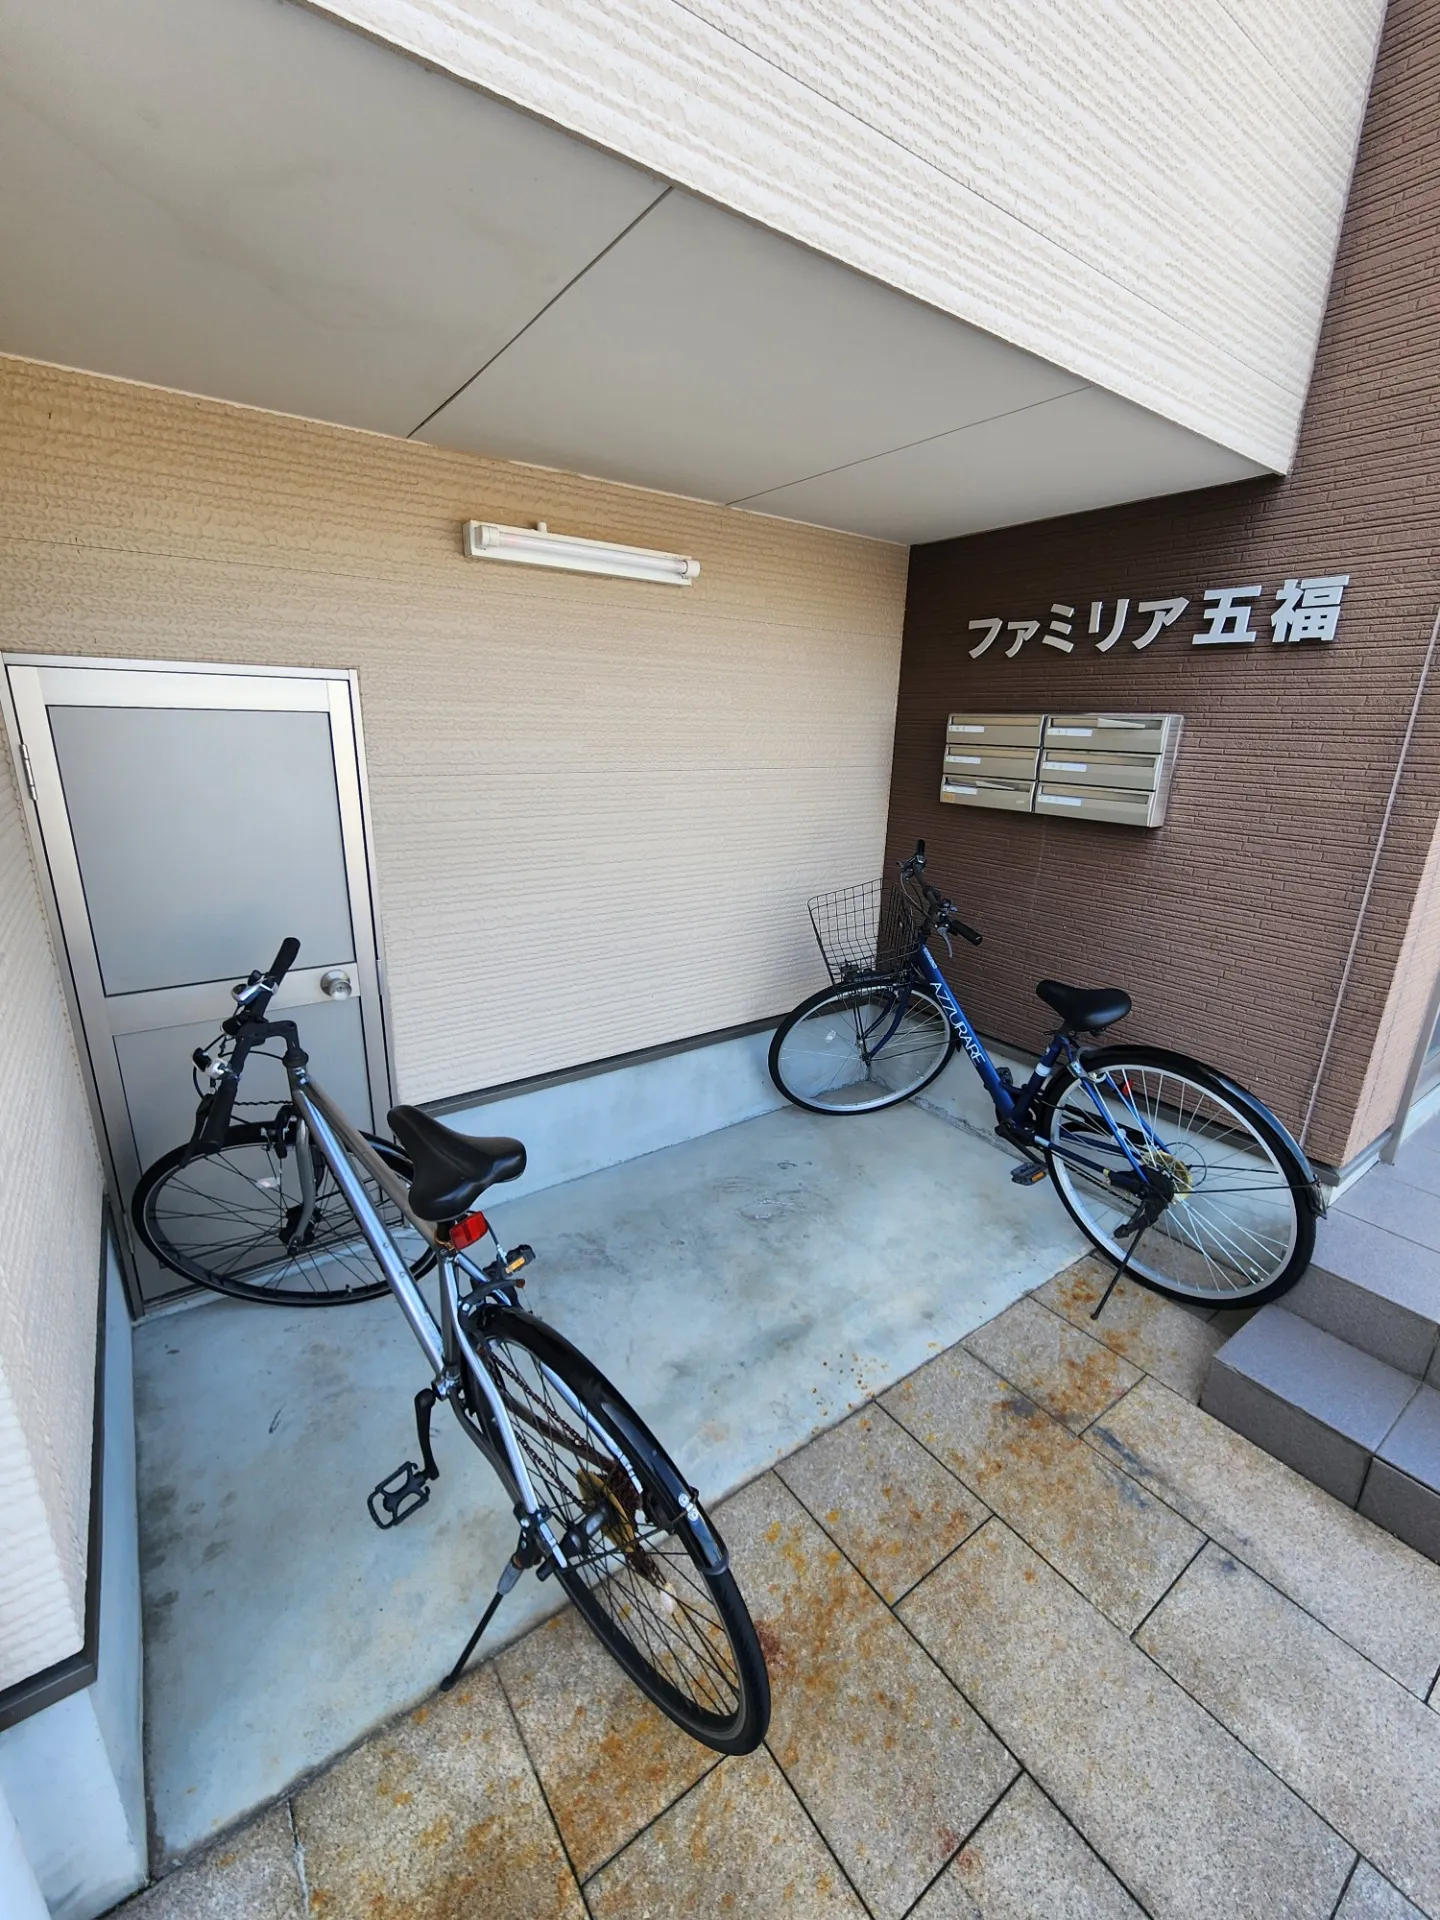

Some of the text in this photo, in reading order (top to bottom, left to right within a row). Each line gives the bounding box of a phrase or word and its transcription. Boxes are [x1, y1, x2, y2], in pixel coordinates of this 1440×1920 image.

[968, 575, 1350, 659] ファミリア五福
